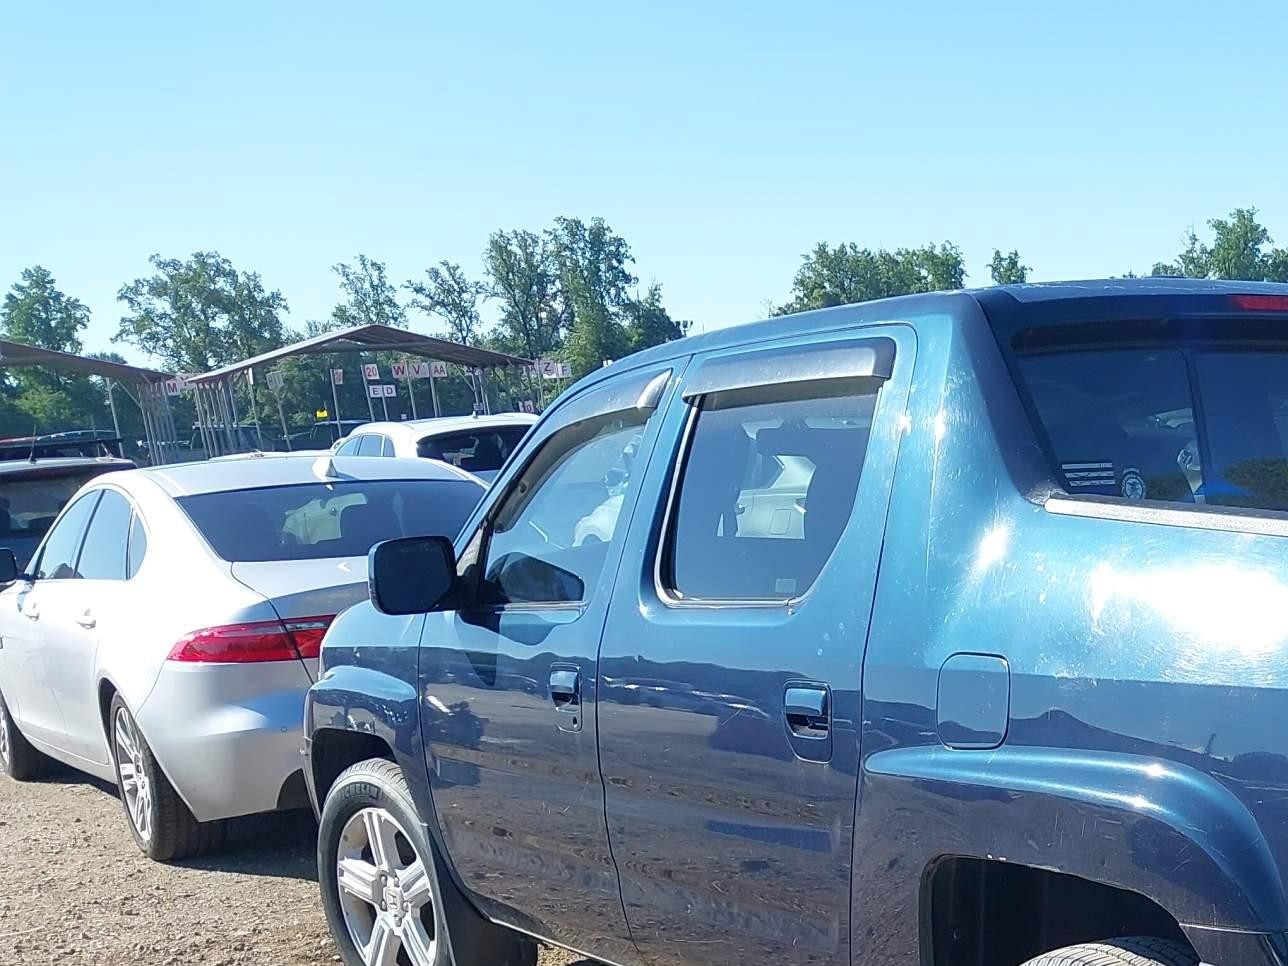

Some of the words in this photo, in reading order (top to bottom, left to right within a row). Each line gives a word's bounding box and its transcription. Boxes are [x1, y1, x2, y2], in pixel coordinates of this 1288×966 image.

[366, 366, 378, 377] 20
[392, 365, 405, 376] W
[433, 365, 446, 375] AA
[543, 362, 552, 372] Z
[561, 365, 568, 376] F
[167, 382, 178, 393] M
[372, 387, 380, 396] E
[386, 386, 393, 395] D
